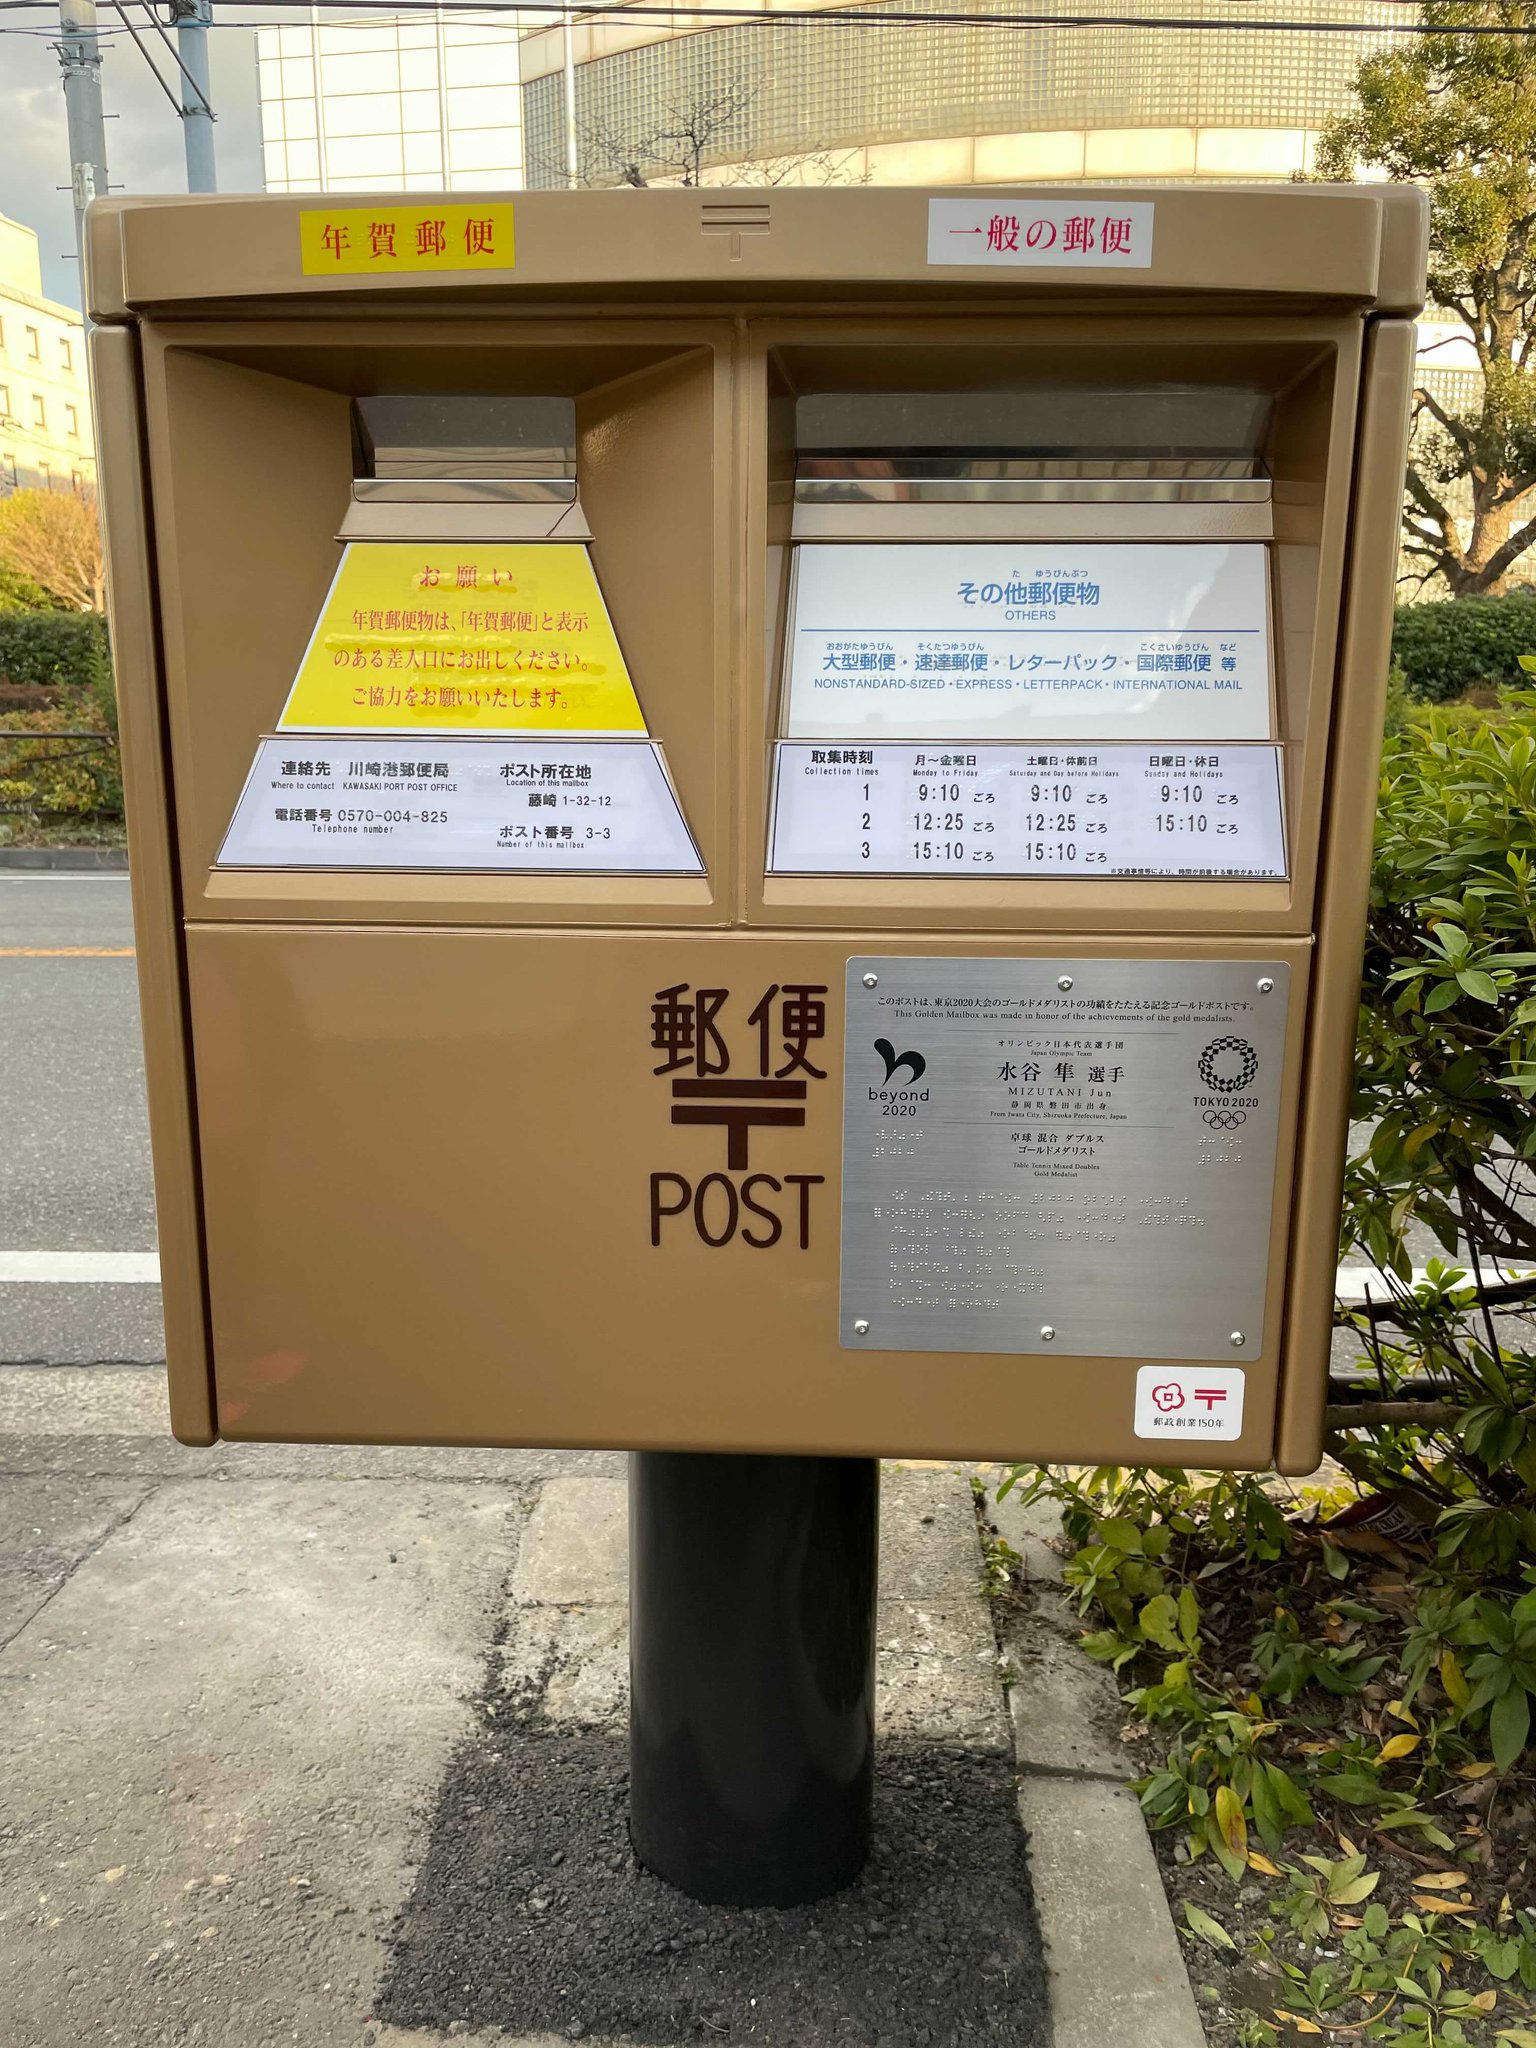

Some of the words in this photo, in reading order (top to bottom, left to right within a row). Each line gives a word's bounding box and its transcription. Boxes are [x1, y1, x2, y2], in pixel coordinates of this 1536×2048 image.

[320, 218, 496, 261] 年賀郵便
[949, 214, 1133, 255] 一般の郵便
[420, 565, 513, 589] お願い
[957, 581, 1100, 606] その他郵便物
[351, 609, 590, 632] 年賀郵便物は、「年賀郵便」と表示
[1005, 610, 1056, 621] OTHERS
[826, 642, 894, 651] おおがたゆうびん
[917, 642, 985, 651] そくたつゆうびん
[1140, 643, 1209, 652] こくさいゆうびん
[1023, 679, 1103, 690] LETTERPACK
[1113, 680, 1210, 690] INTERNATIONAL
[1214, 680, 1242, 690] MAIL
[352, 686, 569, 709] ご協力をお願いいたします。
[811, 750, 873, 765] 取集時刻
[281, 760, 331, 776] 連絡先
[349, 762, 449, 778] 川崎港郵便局
[499, 763, 592, 779] ポスト所在地
[804, 767, 851, 776] Collection
[856, 767, 879, 776] times
[913, 769, 937, 777] Monday
[941, 769, 950, 777] to
[953, 769, 979, 777] Friday
[1173, 770, 1186, 778] and
[1190, 770, 1223, 778] Holidays
[271, 781, 294, 789] Where
[306, 782, 335, 790] contact
[342, 782, 382, 790] KAWASAKI
[384, 783, 404, 791] PORT
[430, 784, 458, 792] OFFICE
[528, 793, 557, 807] 藤崎
[563, 795, 611, 806] 1-32-12
[863, 783, 870, 801] 1
[918, 784, 960, 801] 9:10
[973, 792, 996, 804] ごろ
[1030, 784, 1072, 802] 9:10
[1085, 793, 1108, 804] ごろ
[1161, 784, 1202, 802] 9:10
[1216, 794, 1239, 805] ごろ
[275, 808, 333, 822] 電話番号
[338, 809, 448, 823] 0570-004-825
[312, 824, 358, 834] Telephone
[363, 825, 394, 834] number
[862, 812, 871, 830] 2
[914, 812, 964, 831] 12:25
[973, 821, 995, 833] ごろ
[1026, 813, 1076, 832] 12:25
[1085, 823, 1108, 833] ごろ
[1156, 814, 1207, 832] 15:10
[1216, 823, 1239, 834] ごろ
[499, 825, 574, 839] ポスト番号
[586, 827, 611, 839] 3-3
[496, 840, 521, 848] Number
[556, 841, 584, 849] mailbox
[861, 841, 870, 859] 3
[913, 841, 964, 860] 15:10
[972, 851, 994, 862] ごろ
[1025, 842, 1077, 860] 15:10
[1085, 852, 1107, 863] ごろ
[895, 1010, 912, 1018] This
[915, 1010, 944, 1018] Golden
[946, 1010, 979, 1019] Mailbox
[1001, 1010, 1022, 1019] made
[1025, 1011, 1033, 1019] in
[1035, 1011, 1059, 1020] honor
[1061, 1011, 1070, 1020] of
[1073, 1012, 1086, 1020] the
[1088, 1012, 1144, 1021] achievements
[1146, 1013, 1155, 1021] of
[1157, 1013, 1171, 1022] the
[1173, 1014, 1190, 1023] gold
[650, 983, 828, 1079] 郵便
[1049, 1050, 1074, 1058] Olympic
[997, 1062, 1042, 1082] 水谷
[1054, 1062, 1074, 1083] 隼
[1087, 1066, 1125, 1083] 選手
[868, 1087, 930, 1104] beyond
[1008, 1087, 1082, 1097] MIZUTANI
[1089, 1088, 1112, 1097] Jun
[1193, 1096, 1229, 1107] TOKYO
[1231, 1097, 1259, 1107] 2020
[882, 1105, 916, 1116] 2020
[1011, 1133, 1032, 1143] 卓球
[1037, 1133, 1058, 1143] 混合
[1065, 1133, 1104, 1144] ダブルス
[1018, 1145, 1095, 1156] ゴールドメダリスト
[650, 1172, 825, 1250] POST
[1153, 1417, 1224, 1428] 郵政創業150年
